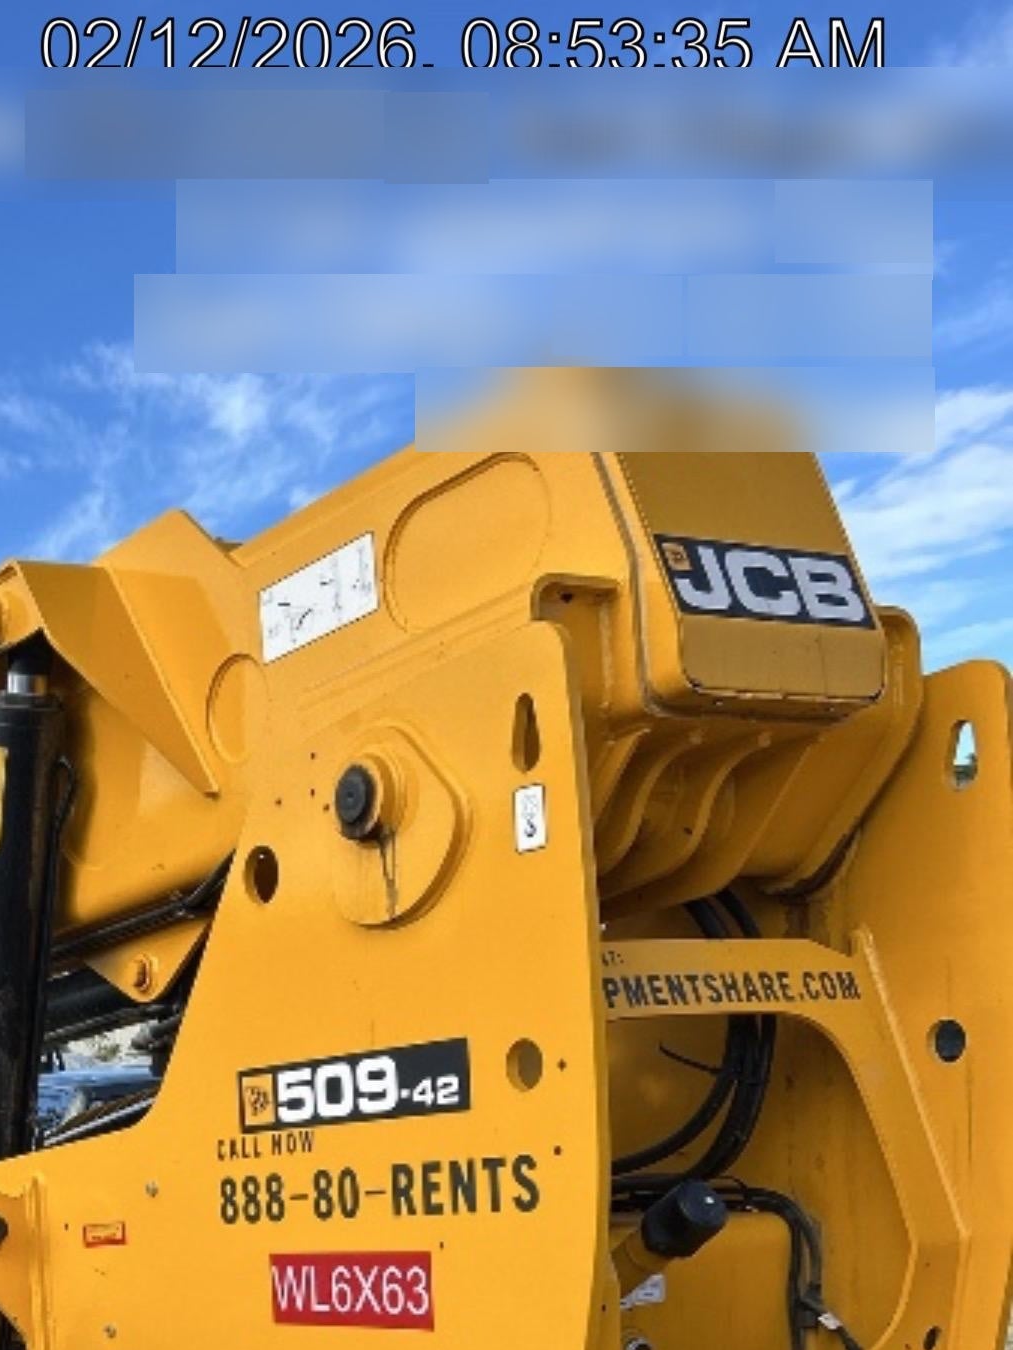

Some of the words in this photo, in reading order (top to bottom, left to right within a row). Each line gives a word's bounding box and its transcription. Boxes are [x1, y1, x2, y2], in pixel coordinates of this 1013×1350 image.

[674, 545, 865, 622] JCB
[601, 971, 861, 1009] PMENTSHARE.COM
[276, 1055, 460, 1123] 509-42
[217, 1138, 262, 1161] CALL
[271, 1130, 316, 1156] NOW
[220, 1154, 541, 1225] 888-80-RENTS
[272, 1264, 430, 1316] WL6X63
